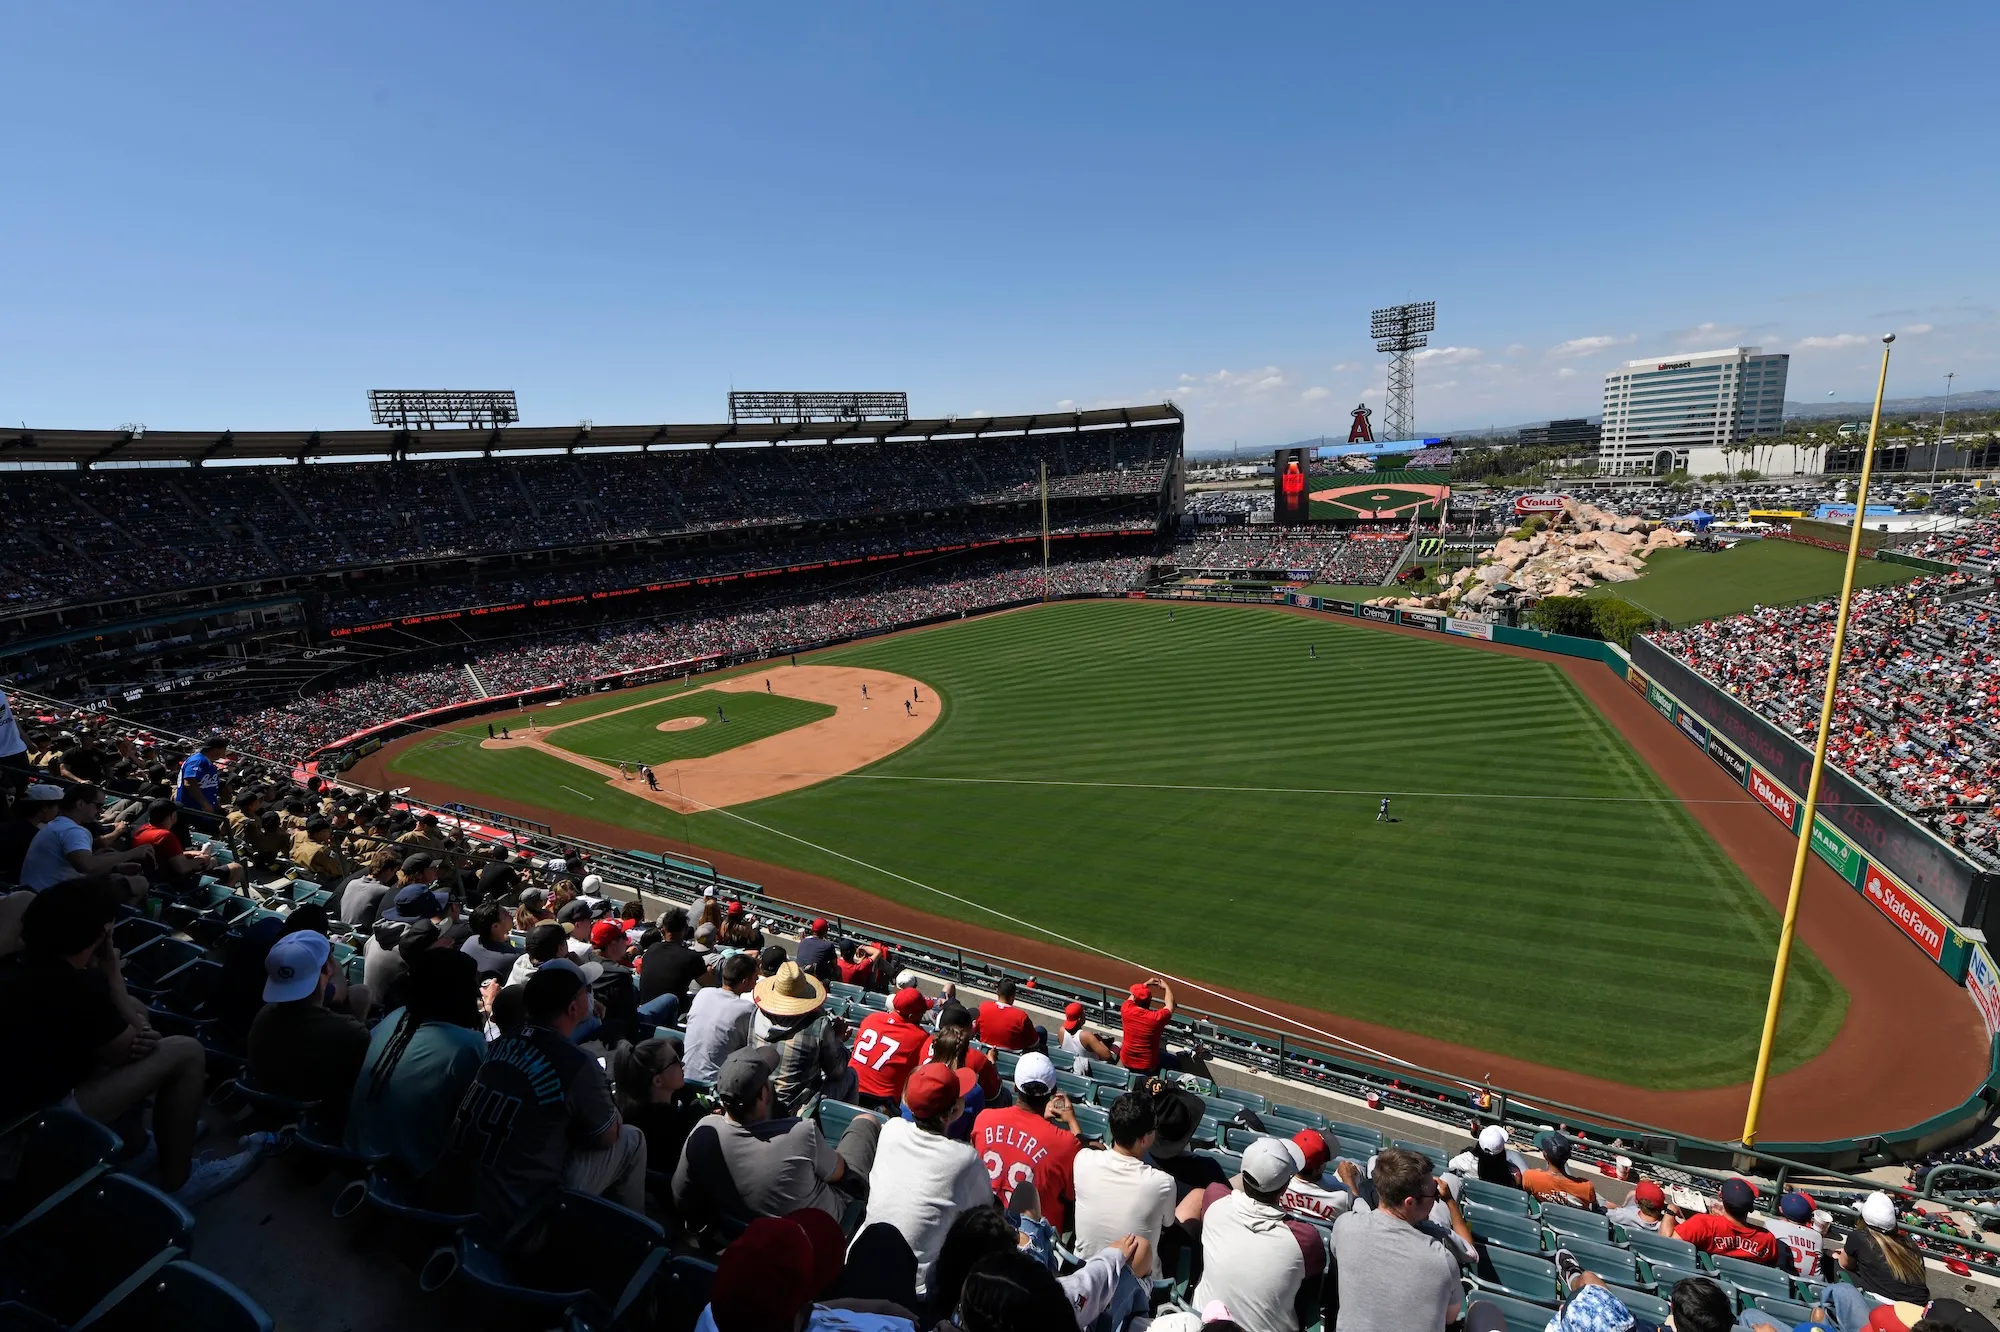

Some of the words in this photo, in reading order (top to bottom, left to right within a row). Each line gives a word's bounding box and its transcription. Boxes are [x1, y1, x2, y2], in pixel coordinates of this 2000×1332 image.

[1526, 497, 1563, 507] Yakult
[1198, 513, 1227, 524] Modelo
[372, 622, 392, 630] SUGAR
[1411, 613, 1437, 623] YOKOHAMA
[314, 646, 345, 656] LEXUS
[216, 666, 247, 677] LEXUS
[1656, 690, 1673, 713] National
[1748, 731, 1784, 768] SUGAR
[1752, 773, 1791, 819] Yakult
[1798, 762, 1840, 812] Cke
[1844, 805, 1886, 846] ZERO
[1813, 826, 1823, 842] VA
[1822, 836, 1839, 854] AIR
[1953, 934, 1963, 948] 365
[853, 1028, 900, 1072] 27
[486, 1038, 565, 1106] DSCHMIDT
[985, 1125, 1048, 1164] BELTRE
[1713, 1235, 1770, 1259] PUJOLS
[1788, 1234, 1816, 1251] TROUT
[1789, 1246, 1819, 1277] 27
